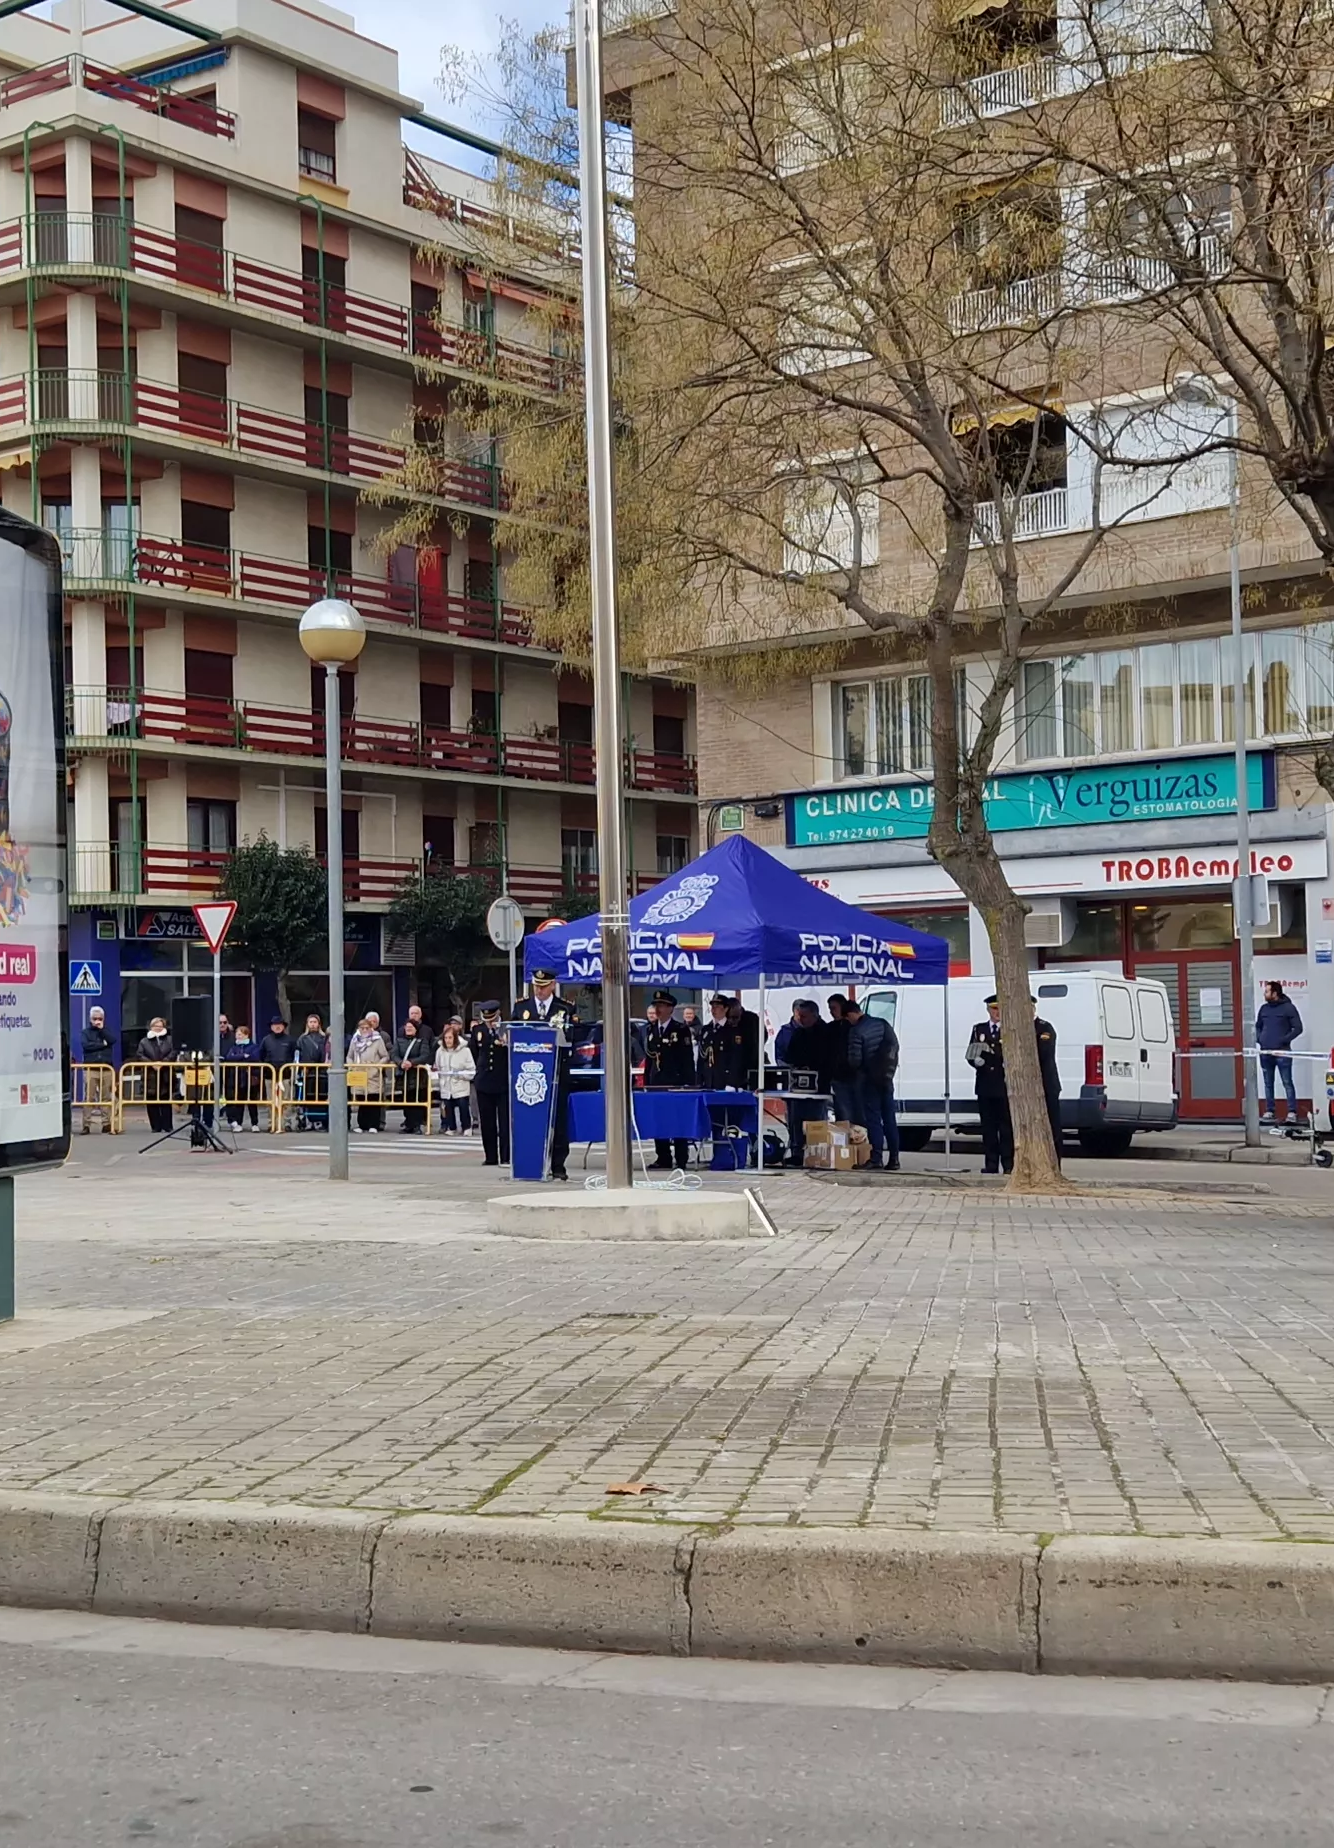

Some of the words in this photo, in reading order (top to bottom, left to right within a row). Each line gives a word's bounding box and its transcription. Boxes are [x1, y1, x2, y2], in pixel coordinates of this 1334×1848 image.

[806, 789, 902, 818] CLINICA
[910, 780, 1006, 809] DEAL
[1048, 764, 1218, 817] Verguizas
[565, 929, 682, 957] POICIA
[9, 952, 30, 976] real
[567, 951, 715, 977] NAONAL
[799, 953, 915, 979] NACIONAL
